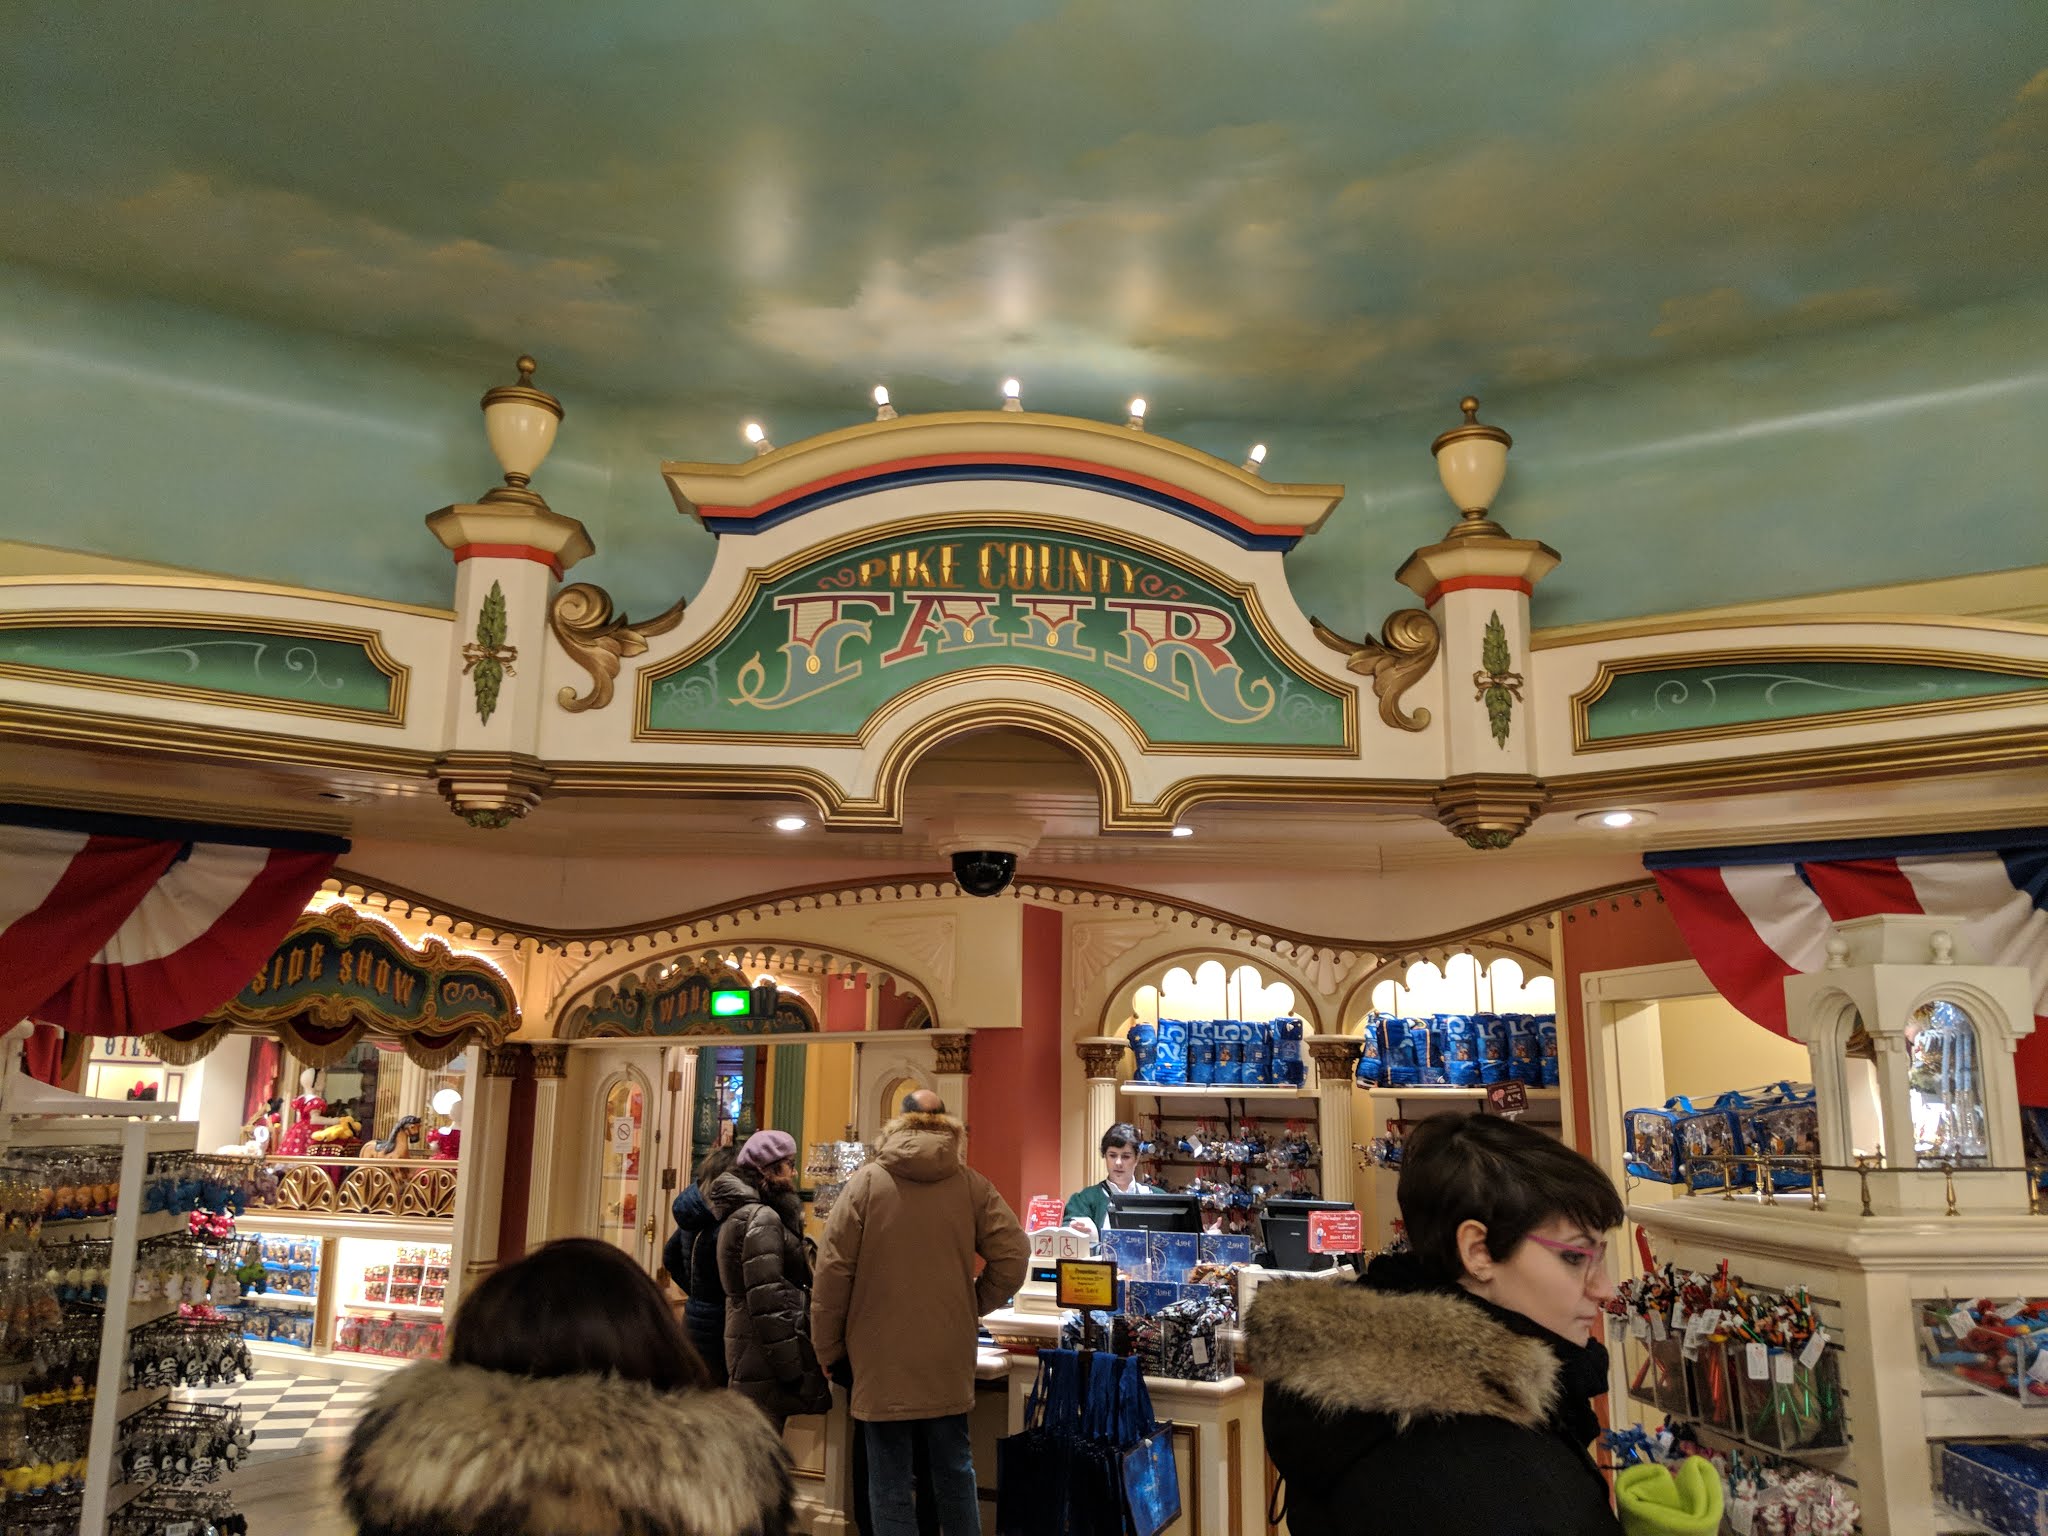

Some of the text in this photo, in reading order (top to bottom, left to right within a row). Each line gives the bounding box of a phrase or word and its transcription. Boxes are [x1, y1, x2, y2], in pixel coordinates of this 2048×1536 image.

[859, 542, 1143, 594] PIKE COUNTY
[729, 591, 1276, 723] FAIR
[251, 942, 416, 1008] SIDE SHOW
